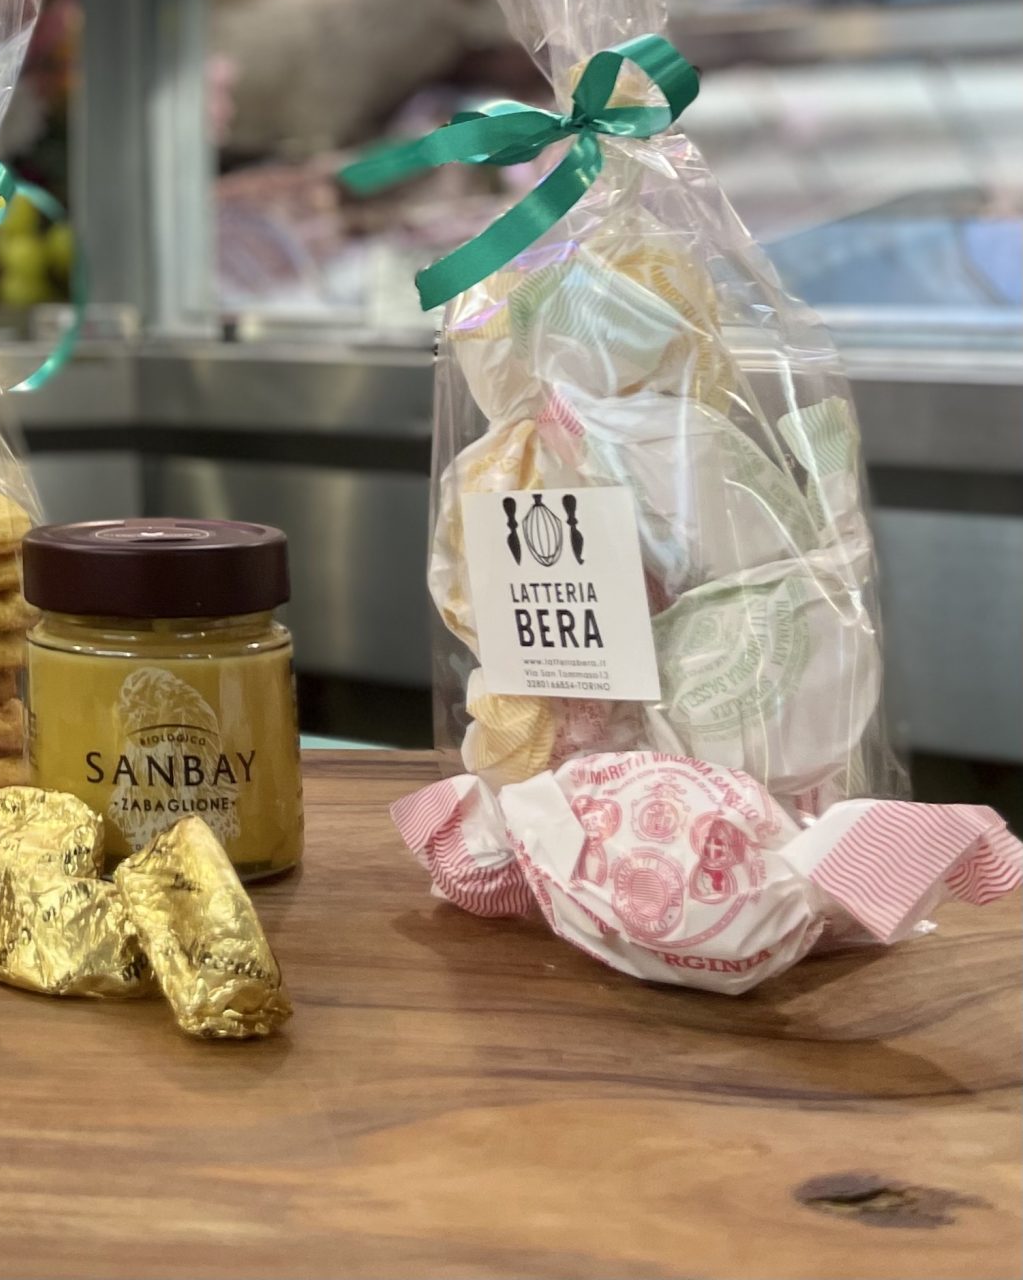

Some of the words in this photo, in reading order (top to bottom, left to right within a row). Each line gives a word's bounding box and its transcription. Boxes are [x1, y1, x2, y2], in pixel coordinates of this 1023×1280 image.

[510, 582, 598, 603] LATTERIA
[515, 609, 604, 648] BERA
[524, 669, 538, 677] Via
[540, 669, 556, 677] San
[139, 733, 207, 746] BIOLOGICO
[85, 750, 256, 788] SANBAY
